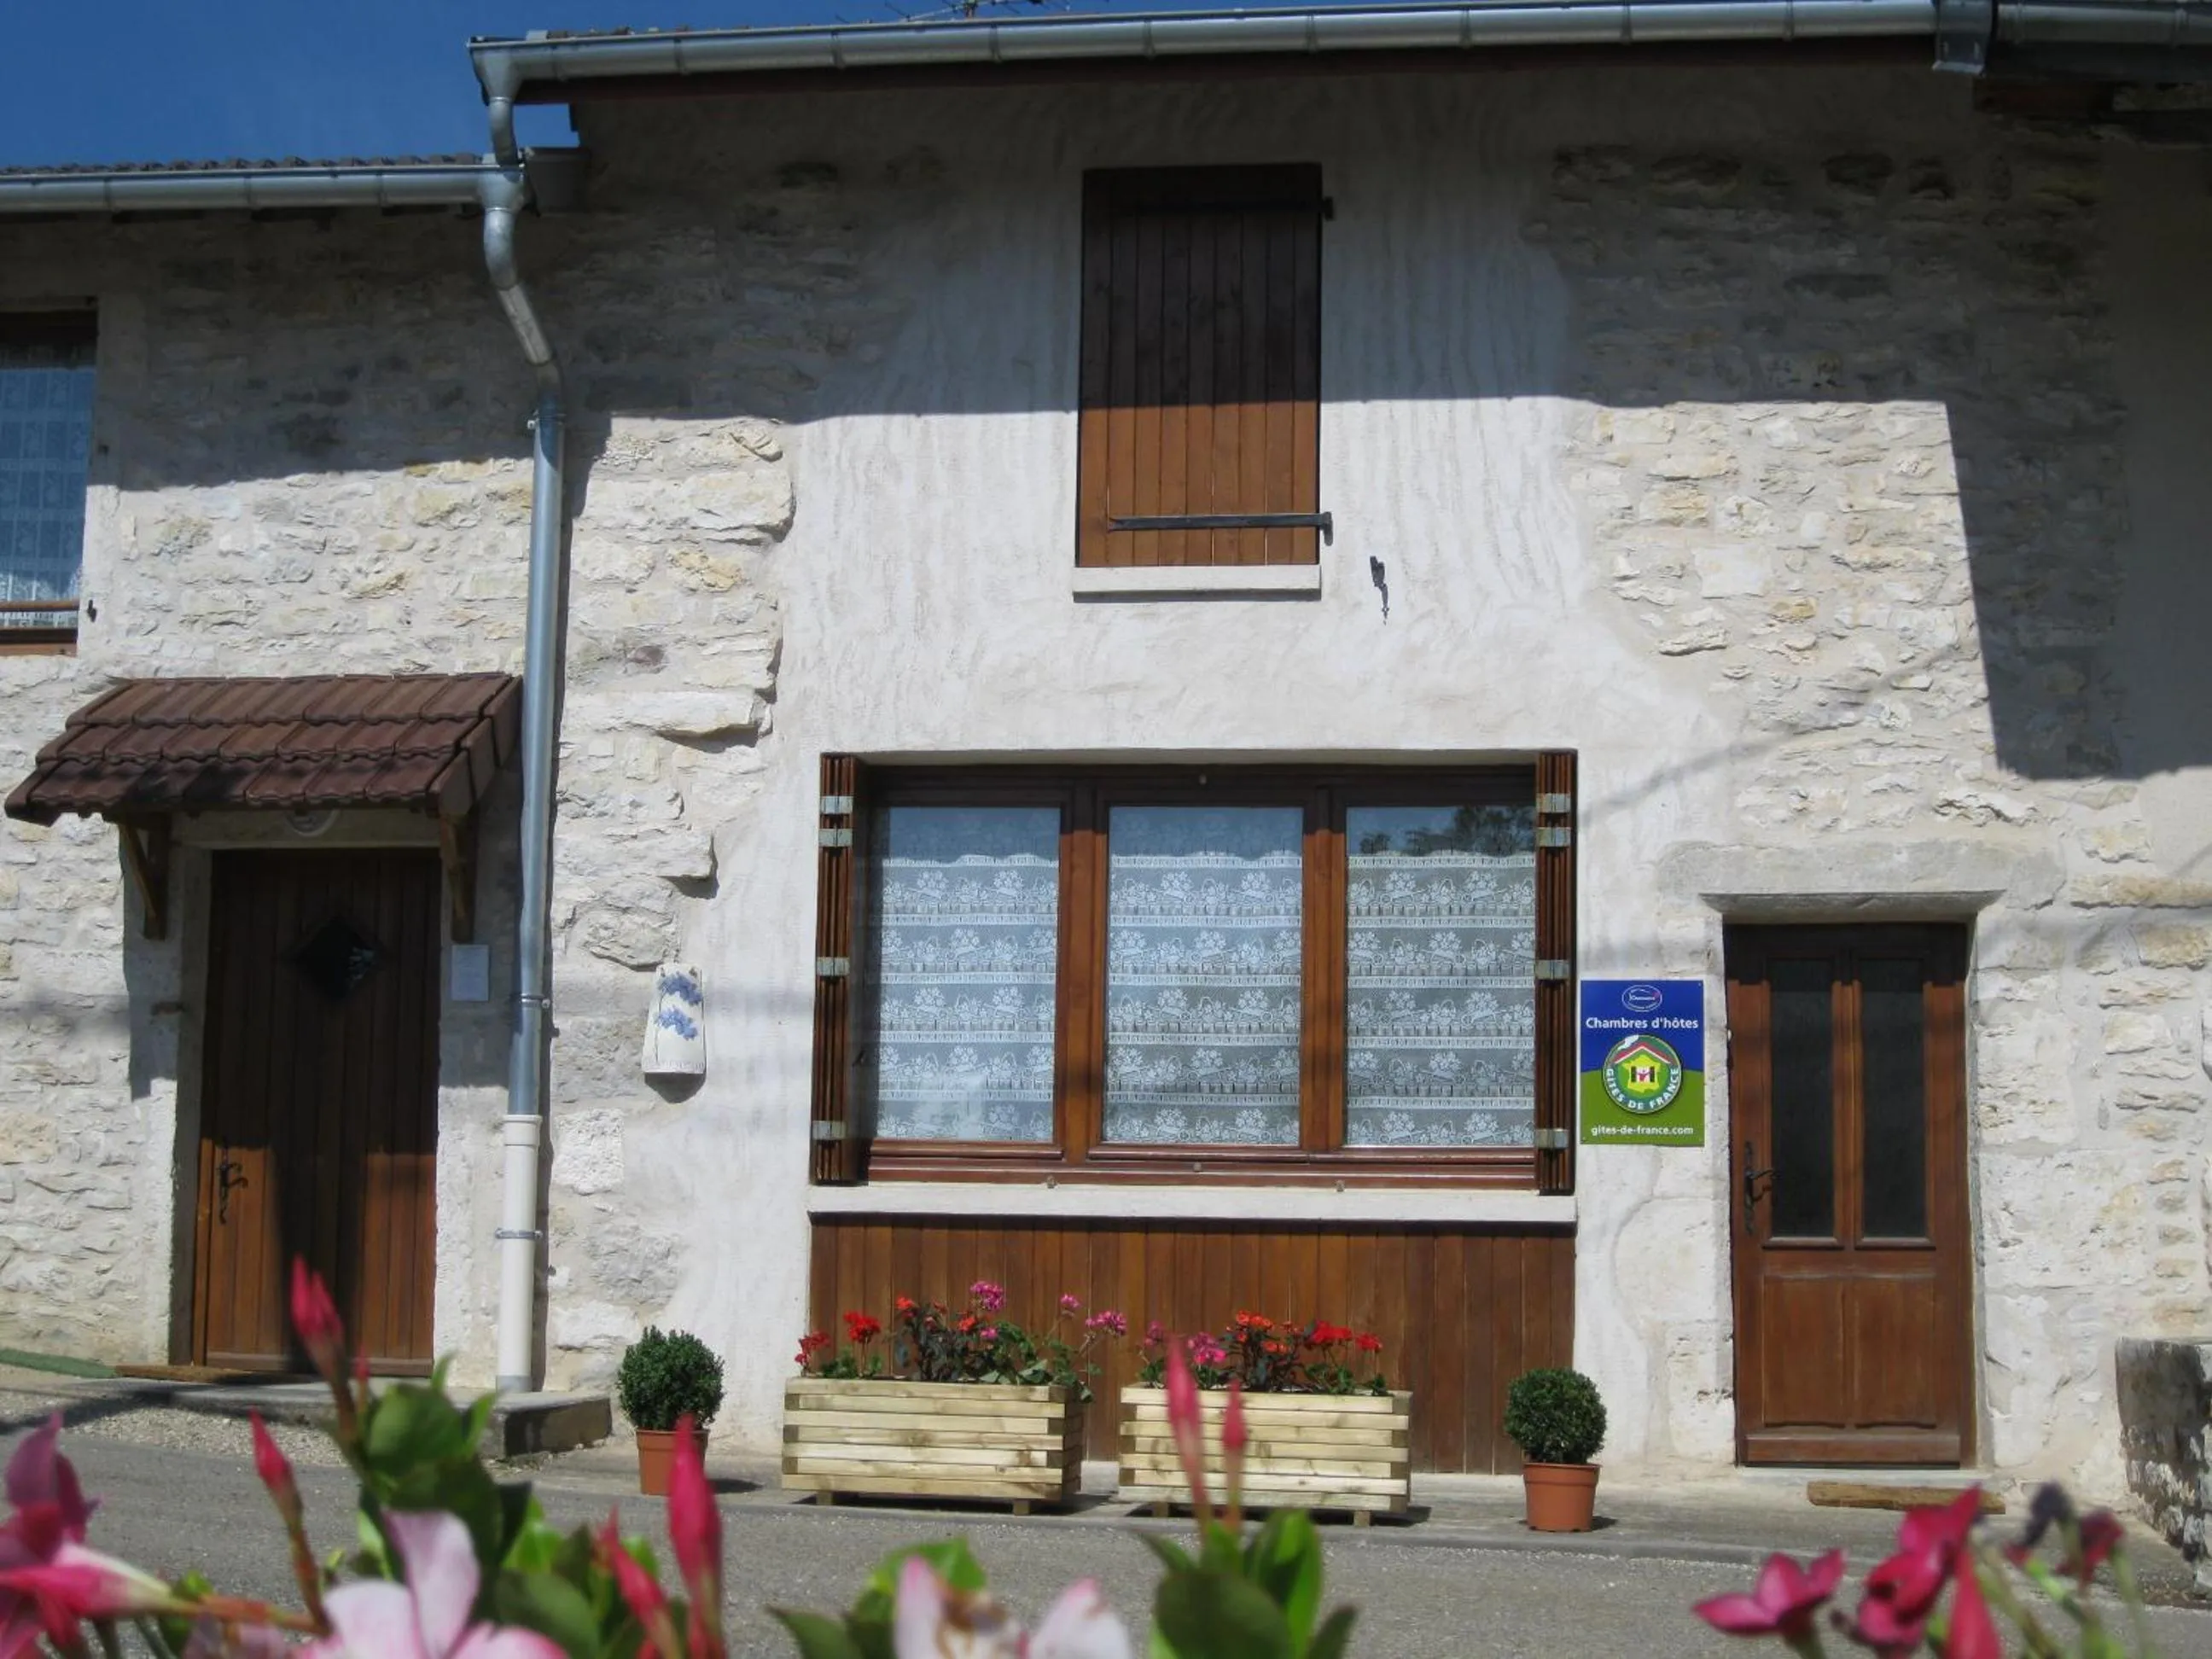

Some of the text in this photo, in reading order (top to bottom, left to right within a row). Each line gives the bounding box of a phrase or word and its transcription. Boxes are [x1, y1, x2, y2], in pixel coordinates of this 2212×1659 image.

[1586, 1017, 1699, 1028] Chambres d'hôtes
[1628, 1100, 1644, 1109] DE
[1650, 1068, 1679, 1109] FRANCE
[1591, 1125, 1694, 1136] gites-de-france.com
